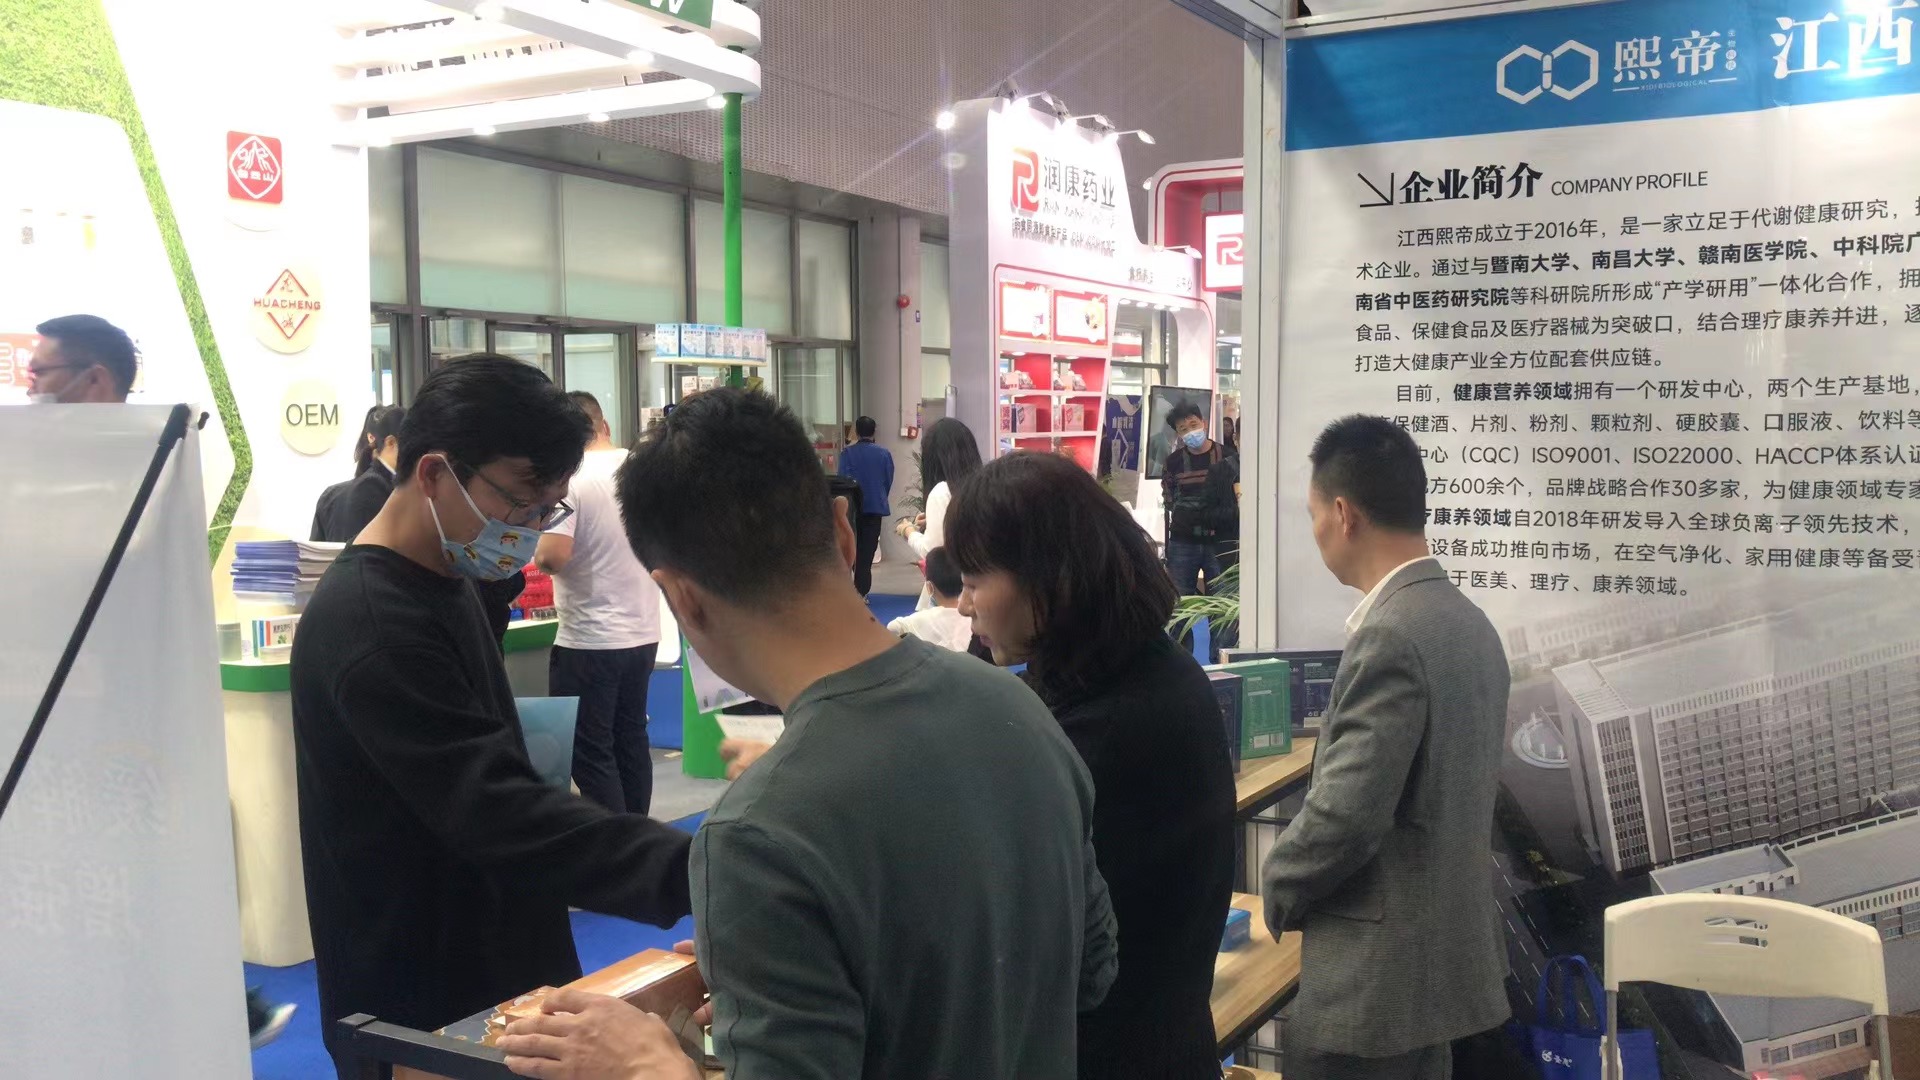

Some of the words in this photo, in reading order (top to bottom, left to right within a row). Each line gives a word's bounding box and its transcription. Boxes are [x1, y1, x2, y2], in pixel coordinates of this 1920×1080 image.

[1770, 0, 1919, 80] 江西
[1613, 30, 1721, 84] 熙帝
[1043, 156, 1116, 209] 润康药业
[1399, 162, 1544, 205] 企业简介
[1551, 176, 1633, 197] COMPANY
[1636, 171, 1709, 192] PROFILE
[1397, 195, 1920, 248] 江西熙帝成立于2016年，是一家立足于代谢健康研究，
[253, 298, 321, 311] HUACHENG
[1354, 347, 1662, 373] 打造大健康产业全方位配套供应链。
[286, 403, 338, 426] OEM
[1381, 408, 1920, 433] 保健酒、片剂、粉剂、颗粒剂、硬胶囊、口服液、饮料等
[1425, 476, 1920, 501] 方600余个，品牌战略合作30多家，为健康领域专家
[1425, 538, 1920, 569] 设备成功推向市场，在空气净化、家用健康等备受
[1444, 569, 1689, 597] 于医美、理疗、康养领域。
